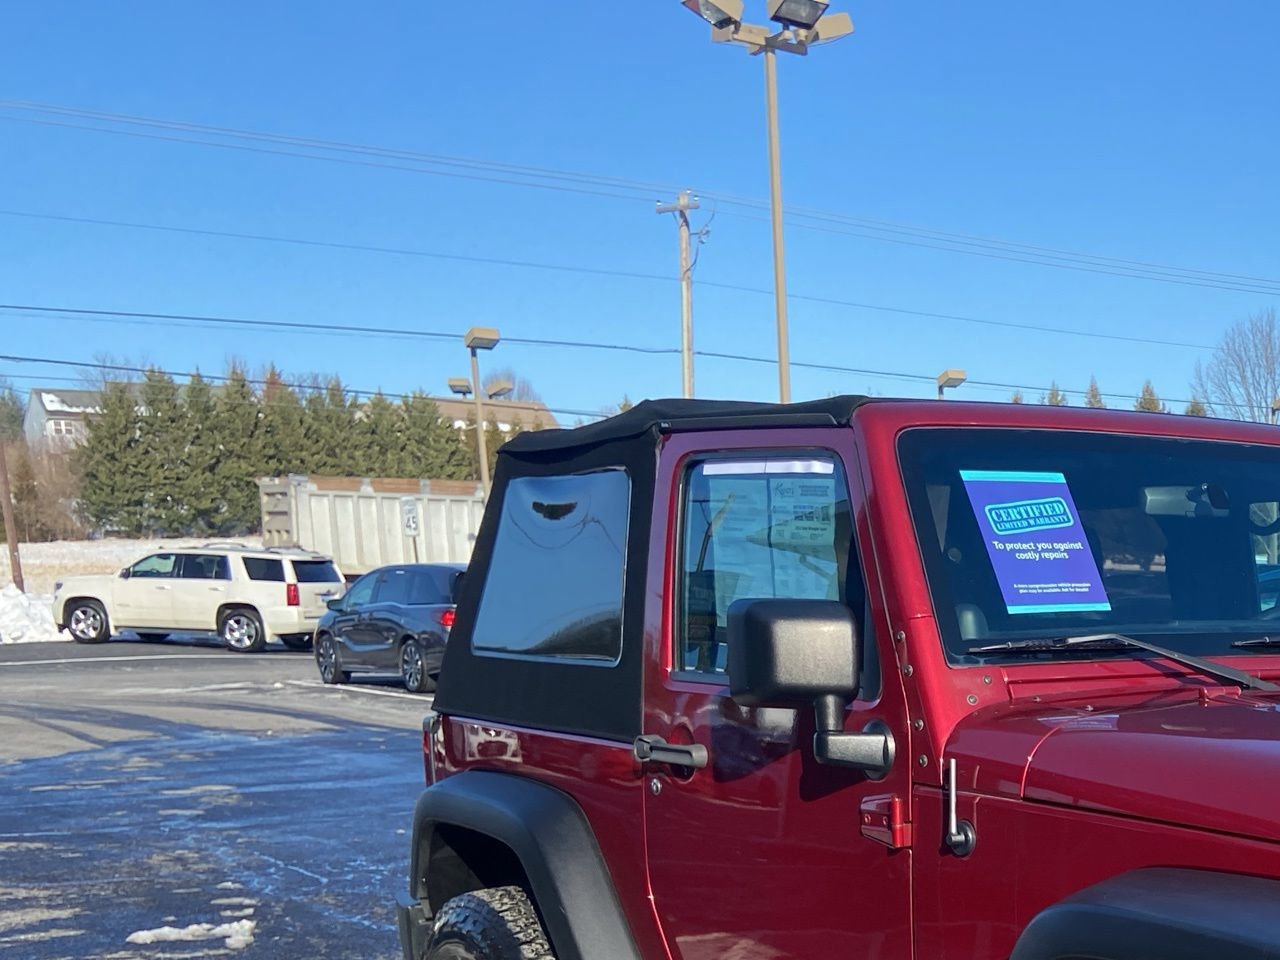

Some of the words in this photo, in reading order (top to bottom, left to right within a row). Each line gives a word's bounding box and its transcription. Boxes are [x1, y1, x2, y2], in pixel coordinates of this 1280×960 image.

[991, 502, 1065, 521] CERTIFIED
[996, 520, 1028, 530] LIMITED
[1029, 515, 1068, 526] WARRANTY
[992, 541, 1005, 550] To
[1006, 541, 1036, 552] protect
[1036, 542, 1053, 552] you
[1053, 541, 1084, 551] against
[1015, 551, 1040, 561] costly
[1041, 551, 1069, 561] repairs
